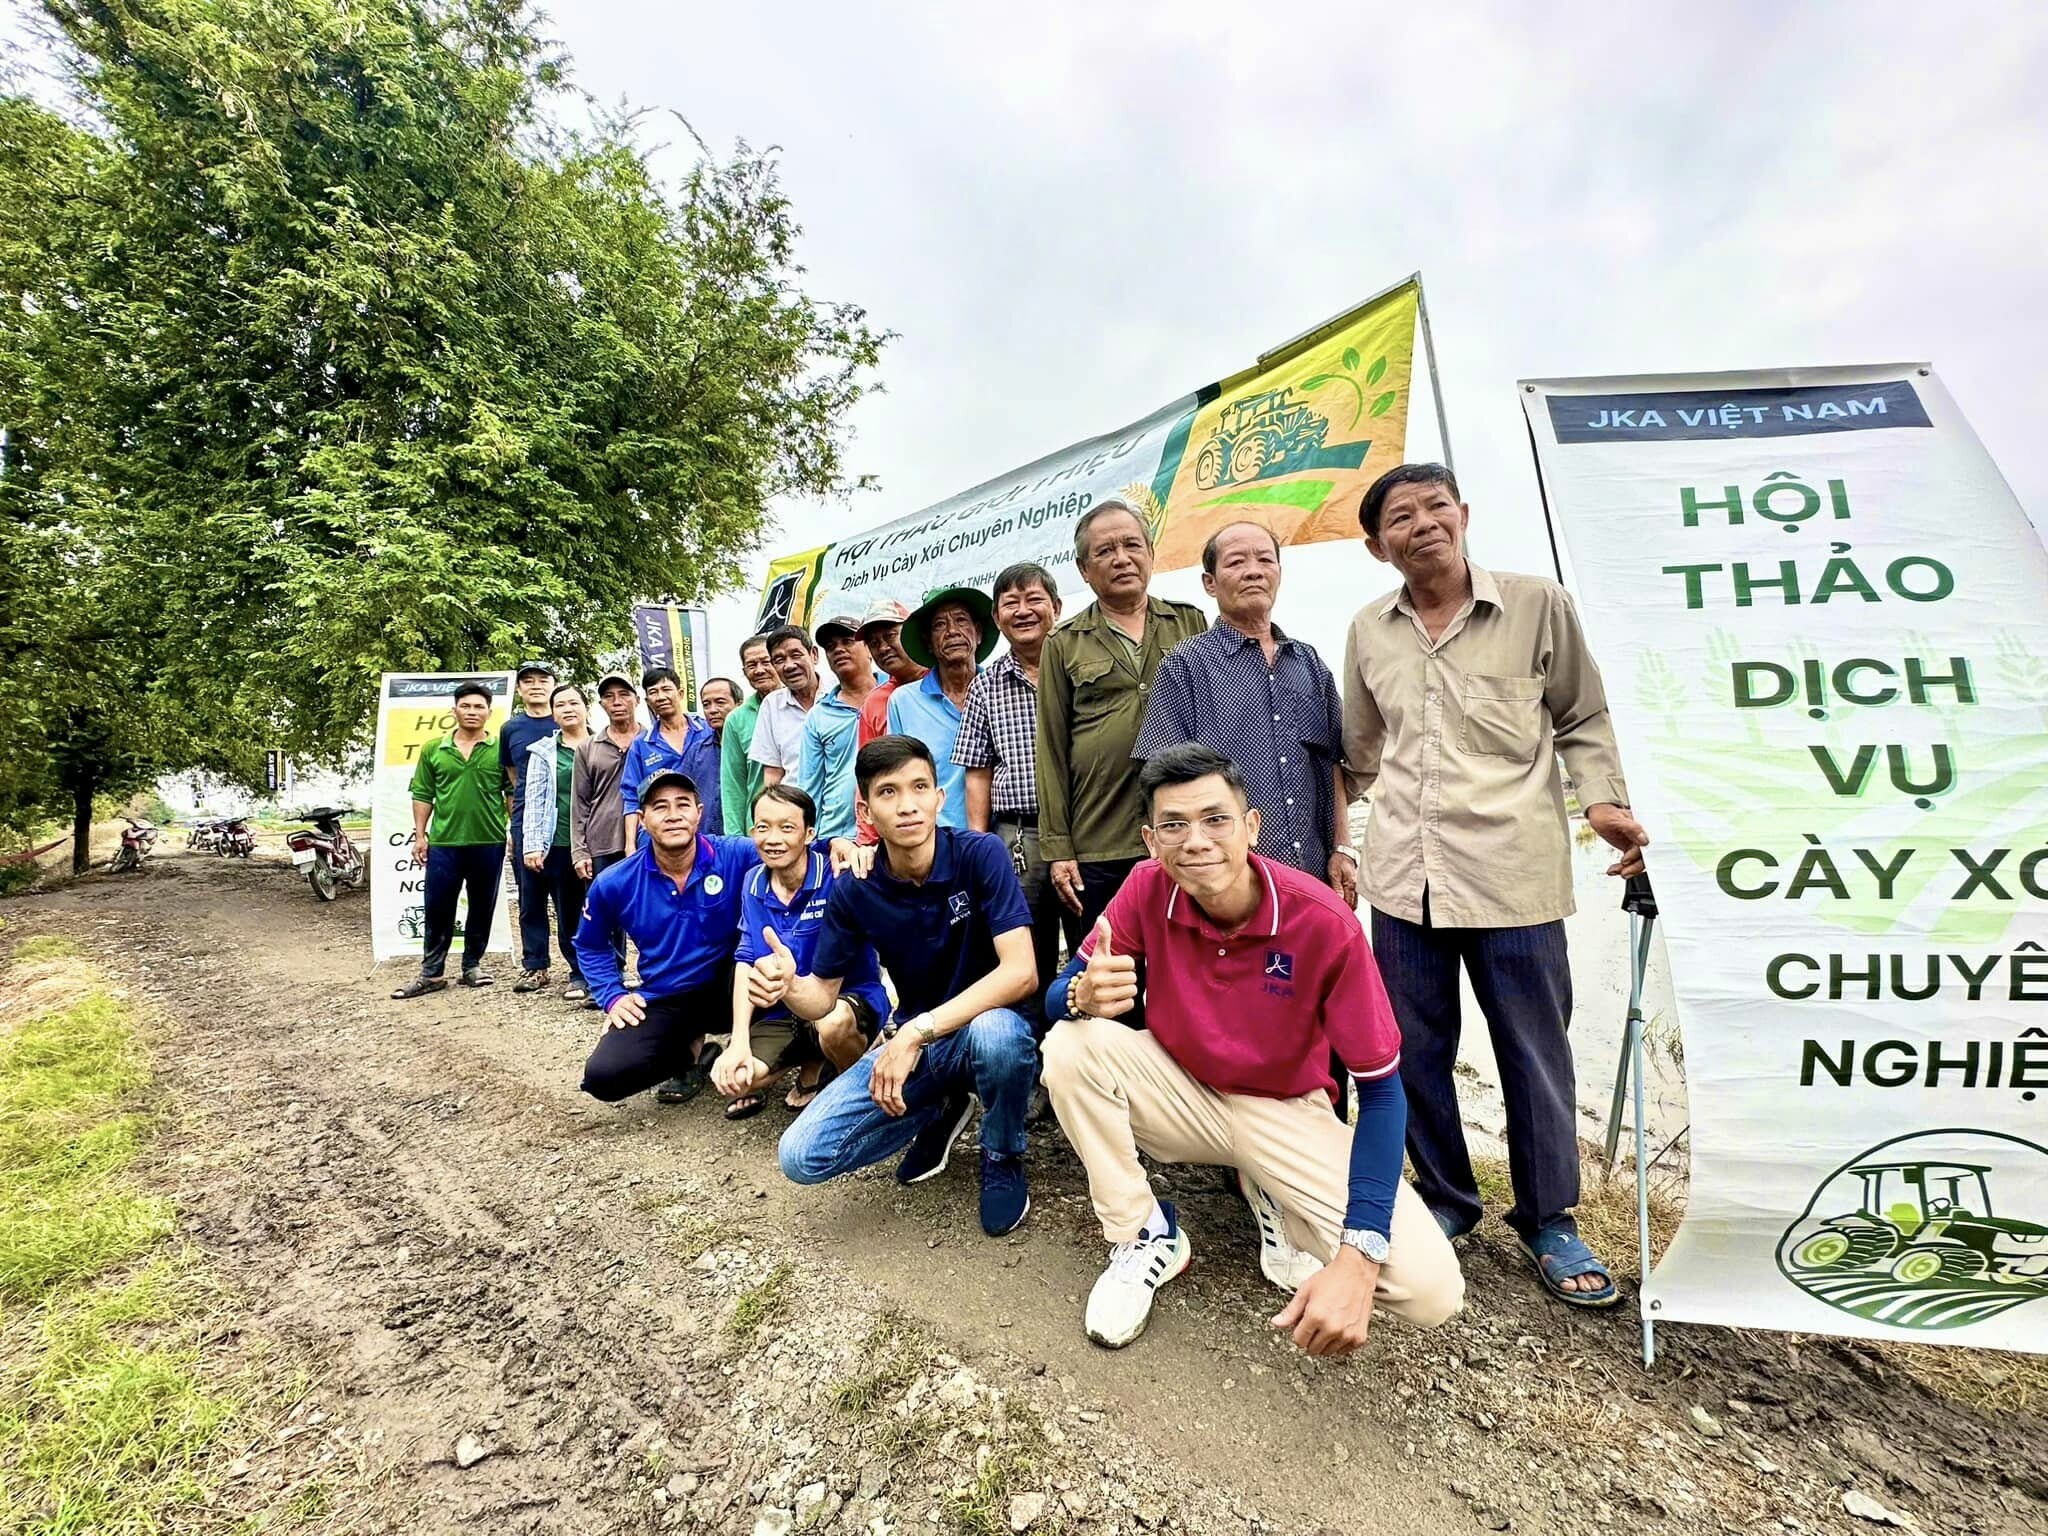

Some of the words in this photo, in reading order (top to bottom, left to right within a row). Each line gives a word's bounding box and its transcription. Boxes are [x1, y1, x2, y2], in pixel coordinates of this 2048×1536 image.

[1587, 409, 1667, 428] JKA
[1676, 403, 1769, 429] VIỆT
[1782, 397, 1888, 422] NAM
[1679, 471, 1851, 533] HỘI
[841, 570, 869, 592] Dịch
[873, 563, 889, 581] Vụ
[892, 553, 918, 573] Cày
[948, 517, 1014, 553] Chuyên
[1017, 492, 1092, 530] Nghiệp
[967, 571, 997, 588] TNHH
[1662, 542, 1955, 609] THẢO
[646, 615, 664, 649] JKA
[650, 652, 667, 669] VI
[400, 683, 428, 692] JKA
[1731, 657, 1977, 719] DỊCH
[415, 709, 457, 733] HỘ
[1808, 744, 1958, 810] VỤ
[1716, 834, 1916, 900] CÀY
[1766, 941, 2048, 1000] CHUYÊ
[1799, 1027, 2048, 1101] NGHIỆ
